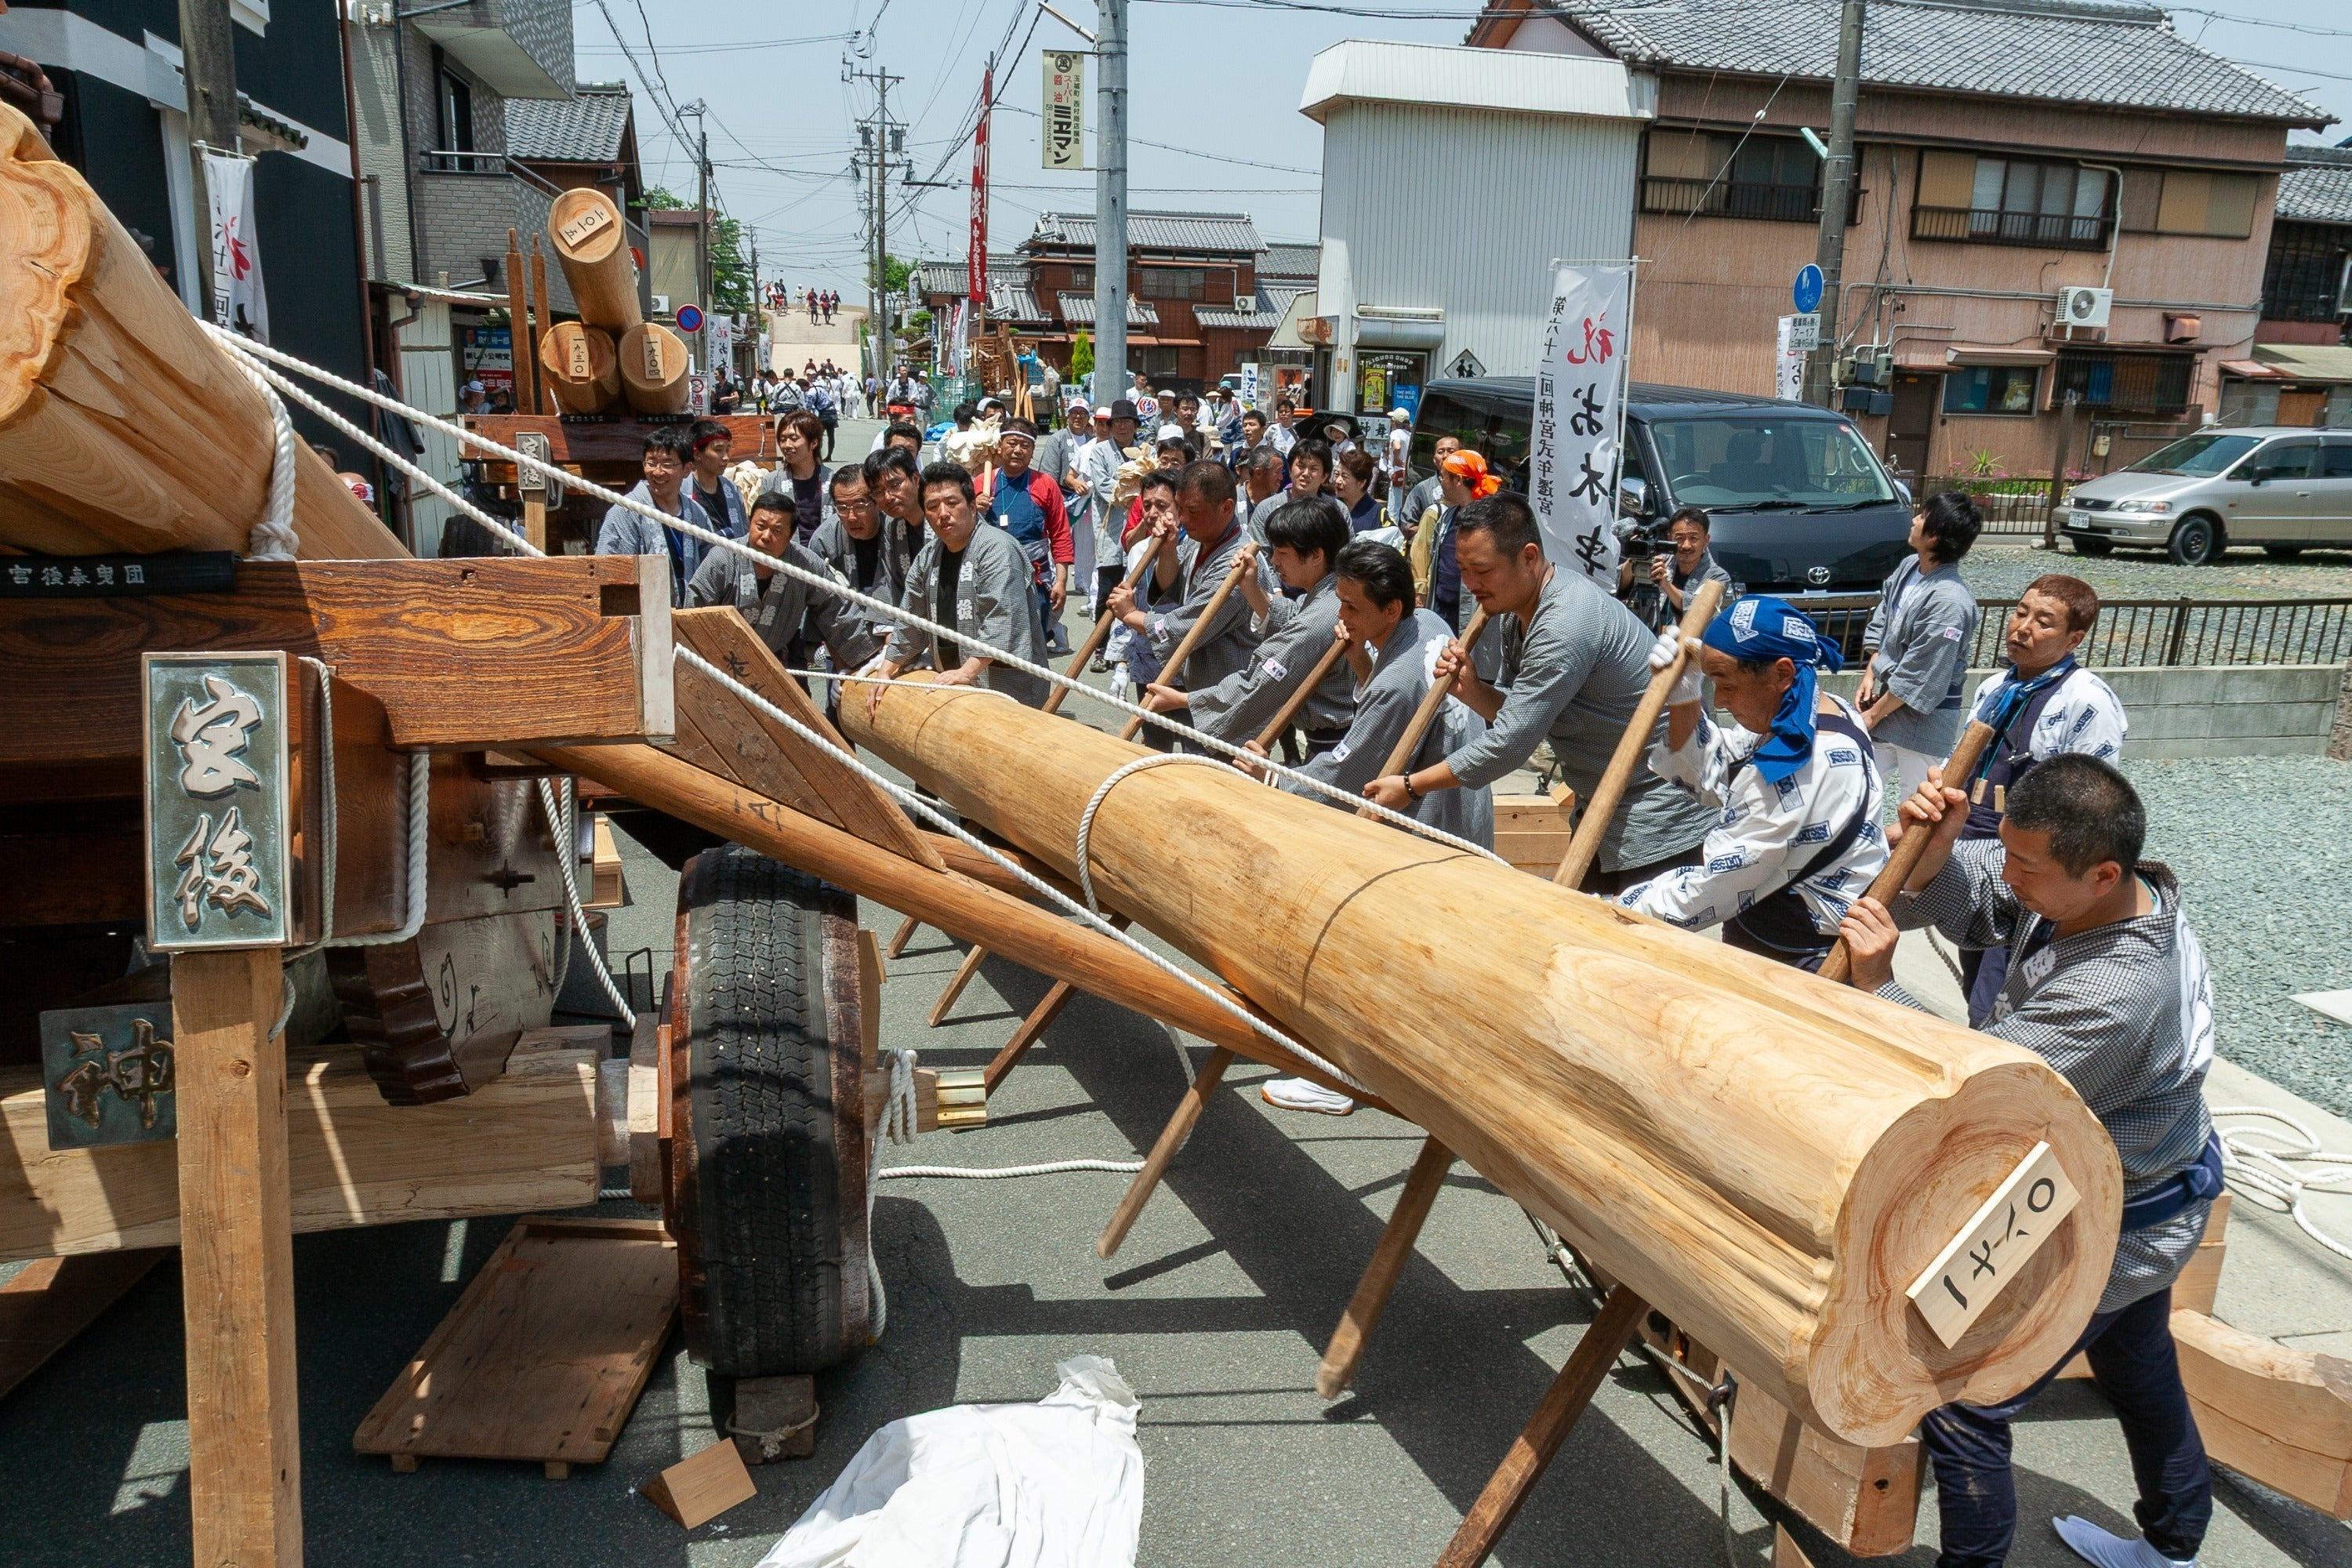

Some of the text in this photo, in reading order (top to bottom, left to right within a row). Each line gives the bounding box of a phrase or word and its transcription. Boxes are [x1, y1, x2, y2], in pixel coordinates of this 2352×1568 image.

[1064, 75, 1073, 103] スーパー
[1794, 328, 1815, 337] 7-17
[572, 338, 585, 374] 一九三〇
[646, 340, 661, 376] 一九〇四
[1368, 354, 1414, 365] LIQUOR SHOP
[9, 564, 145, 586] 宮後奉曳団
[172, 674, 272, 931] 宮後
